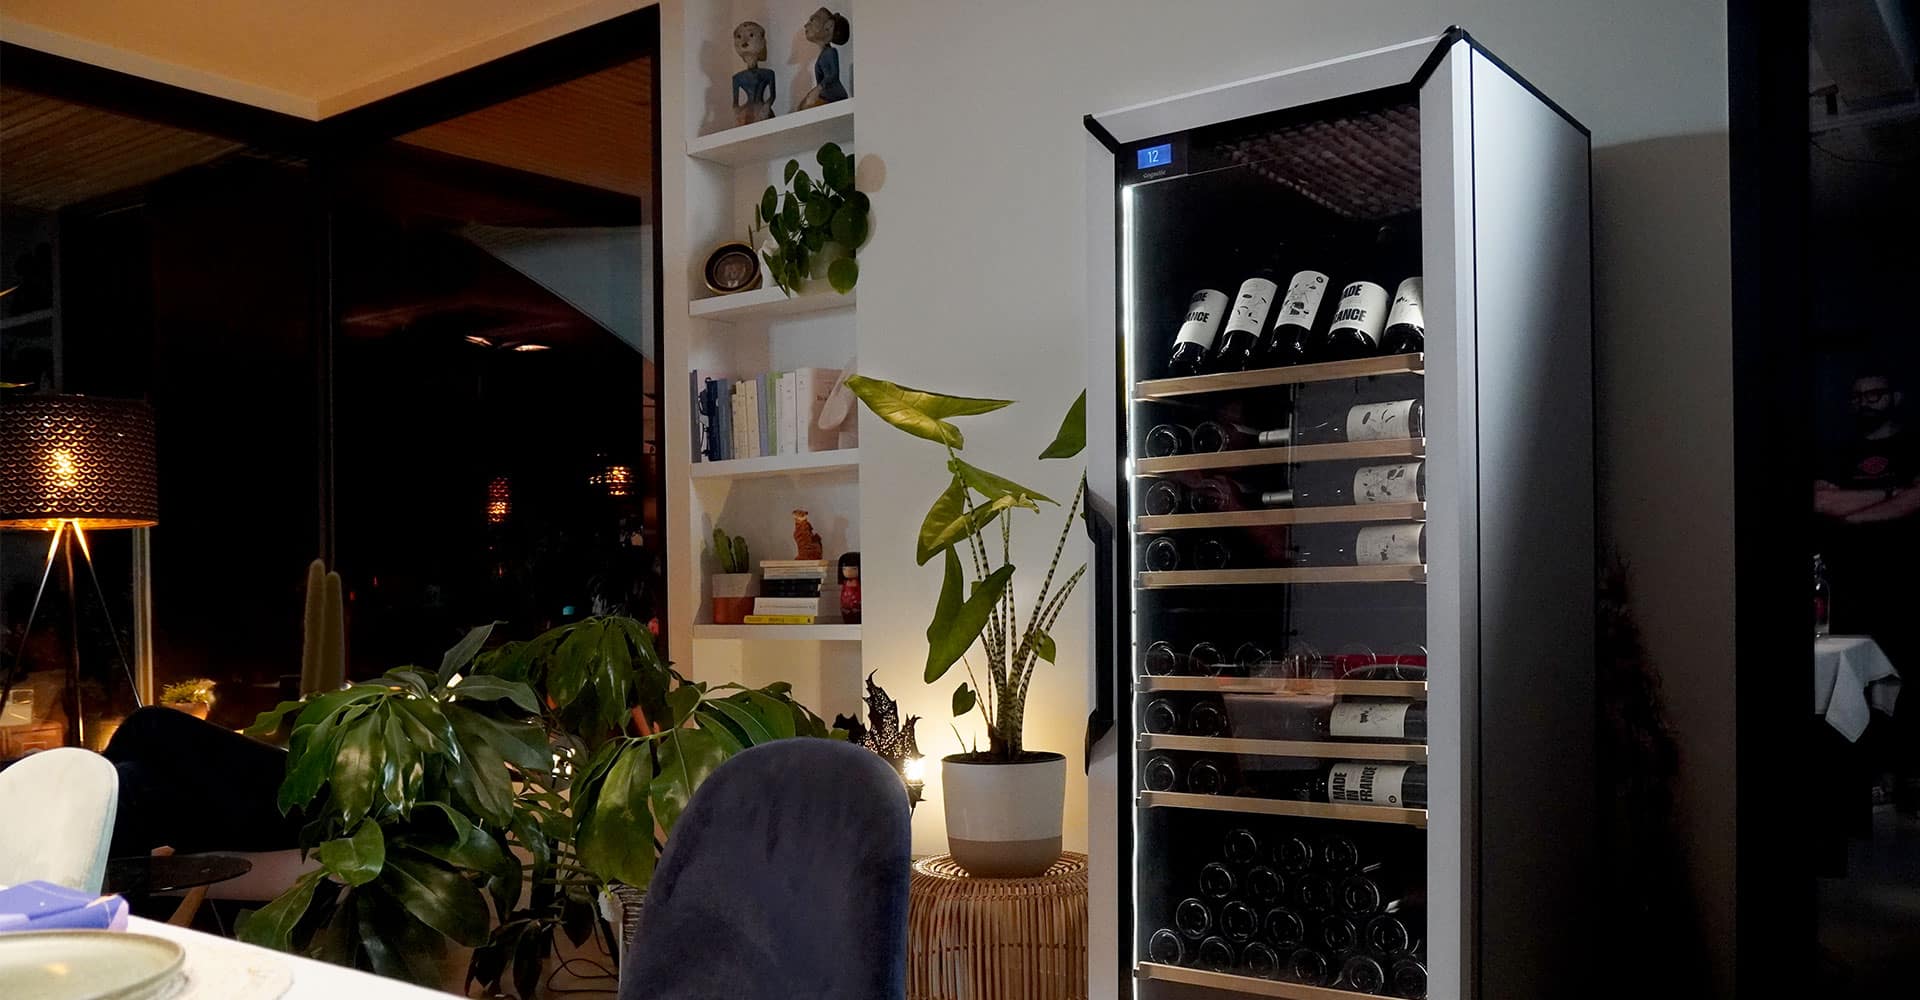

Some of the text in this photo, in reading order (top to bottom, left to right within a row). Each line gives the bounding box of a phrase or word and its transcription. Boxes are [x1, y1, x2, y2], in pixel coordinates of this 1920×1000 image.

[1147, 150, 1160, 164] 12
[1343, 284, 1363, 298] ADE
[1332, 772, 1348, 800] MADE
[1360, 766, 1378, 802] FRANCE
[1346, 790, 1360, 801] IN
